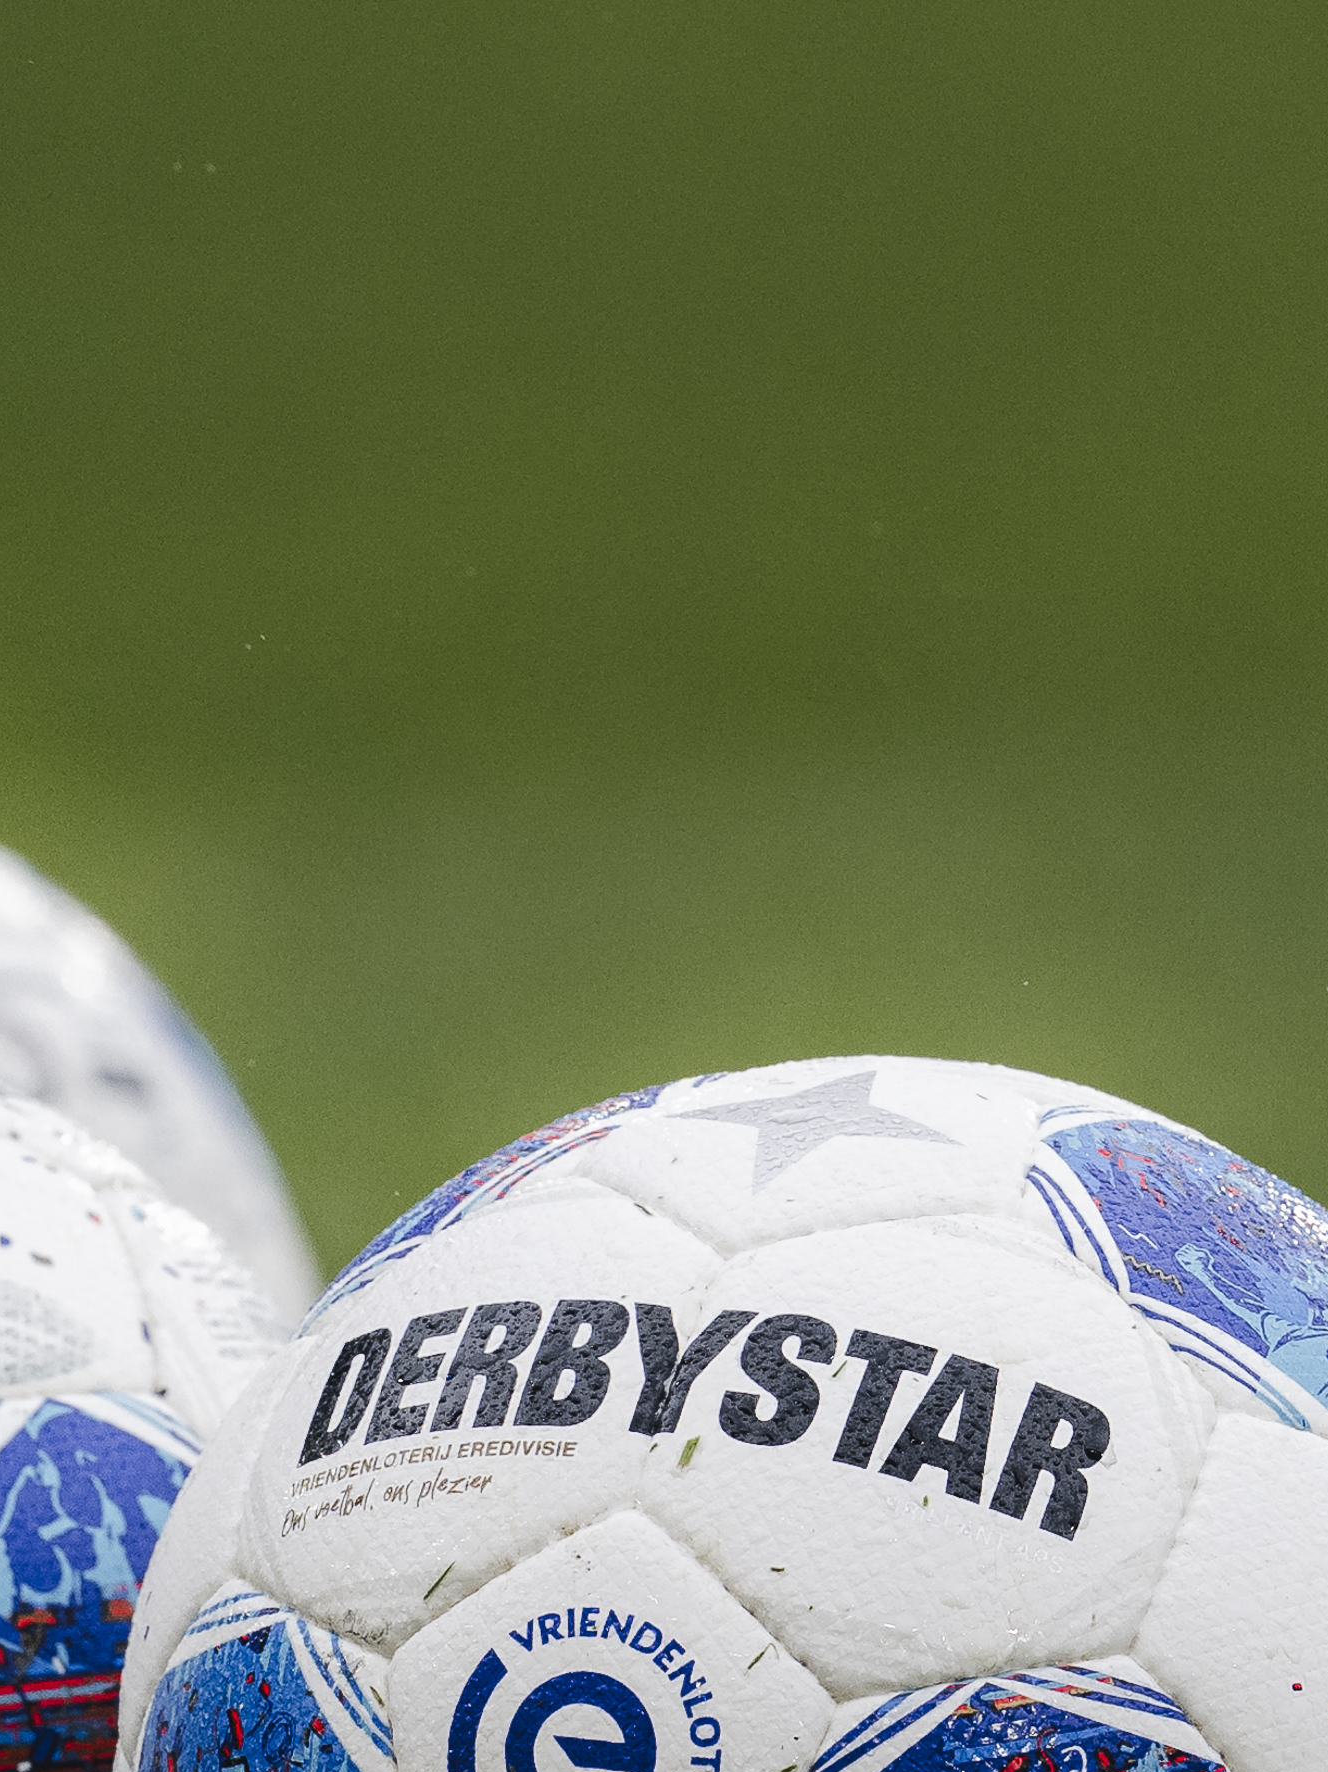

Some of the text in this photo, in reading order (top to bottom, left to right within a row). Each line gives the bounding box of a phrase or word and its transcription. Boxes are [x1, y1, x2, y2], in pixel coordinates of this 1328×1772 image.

[298, 1297, 1111, 1541] DERBYSTAR
[291, 1440, 579, 1498] VRIENDENLOTERIJ EREDIVISIE
[416, 1467, 495, 1508] plezier
